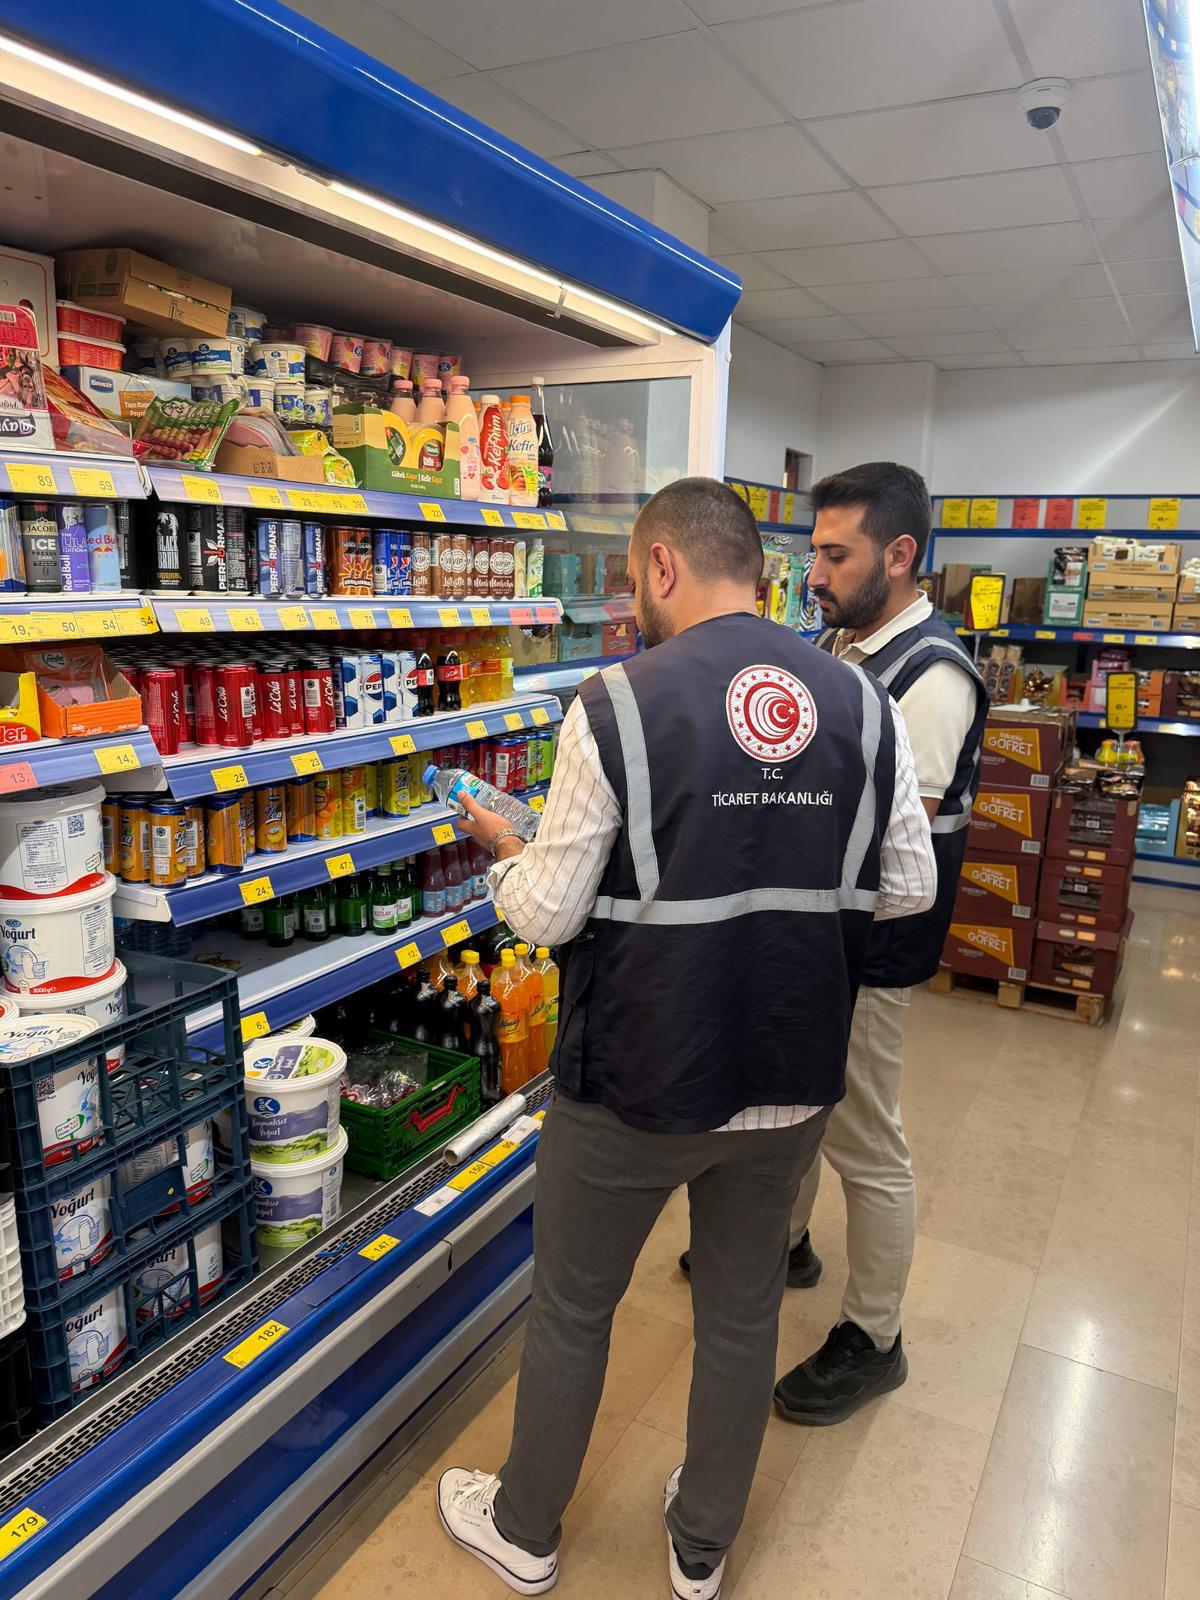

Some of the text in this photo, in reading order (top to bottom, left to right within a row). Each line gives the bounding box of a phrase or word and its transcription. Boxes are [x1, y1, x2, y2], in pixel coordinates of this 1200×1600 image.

[38, 475, 53, 487] 89
[99, 480, 112, 491] 59
[27, 525, 56, 533] JACOBS
[31, 538, 56, 551] ICE
[157, 535, 178, 551] BLACK
[102, 619, 116, 630] 54
[140, 616, 154, 627] 54
[199, 616, 211, 626] 49
[297, 613, 307, 623] 25
[61, 622, 76, 633] 50
[0, 725, 27, 744] der
[988, 736, 1033, 757] GOFRET
[310, 758, 320, 767] 23
[234, 774, 245, 783] 25
[761, 767, 783, 780] T.C.
[712, 790, 833, 807] TİCARET BAKANLIĞI
[979, 801, 1024, 823] GOFRET
[971, 870, 1012, 891] GOFRET
[0, 924, 36, 943] Yoğurt
[967, 932, 1008, 953] GOFRET
[50, 1188, 95, 1220] Yoğurt
[65, 1304, 103, 1334] oğurt
[257, 1324, 281, 1342] 182
[11, 1516, 38, 1538] 179
